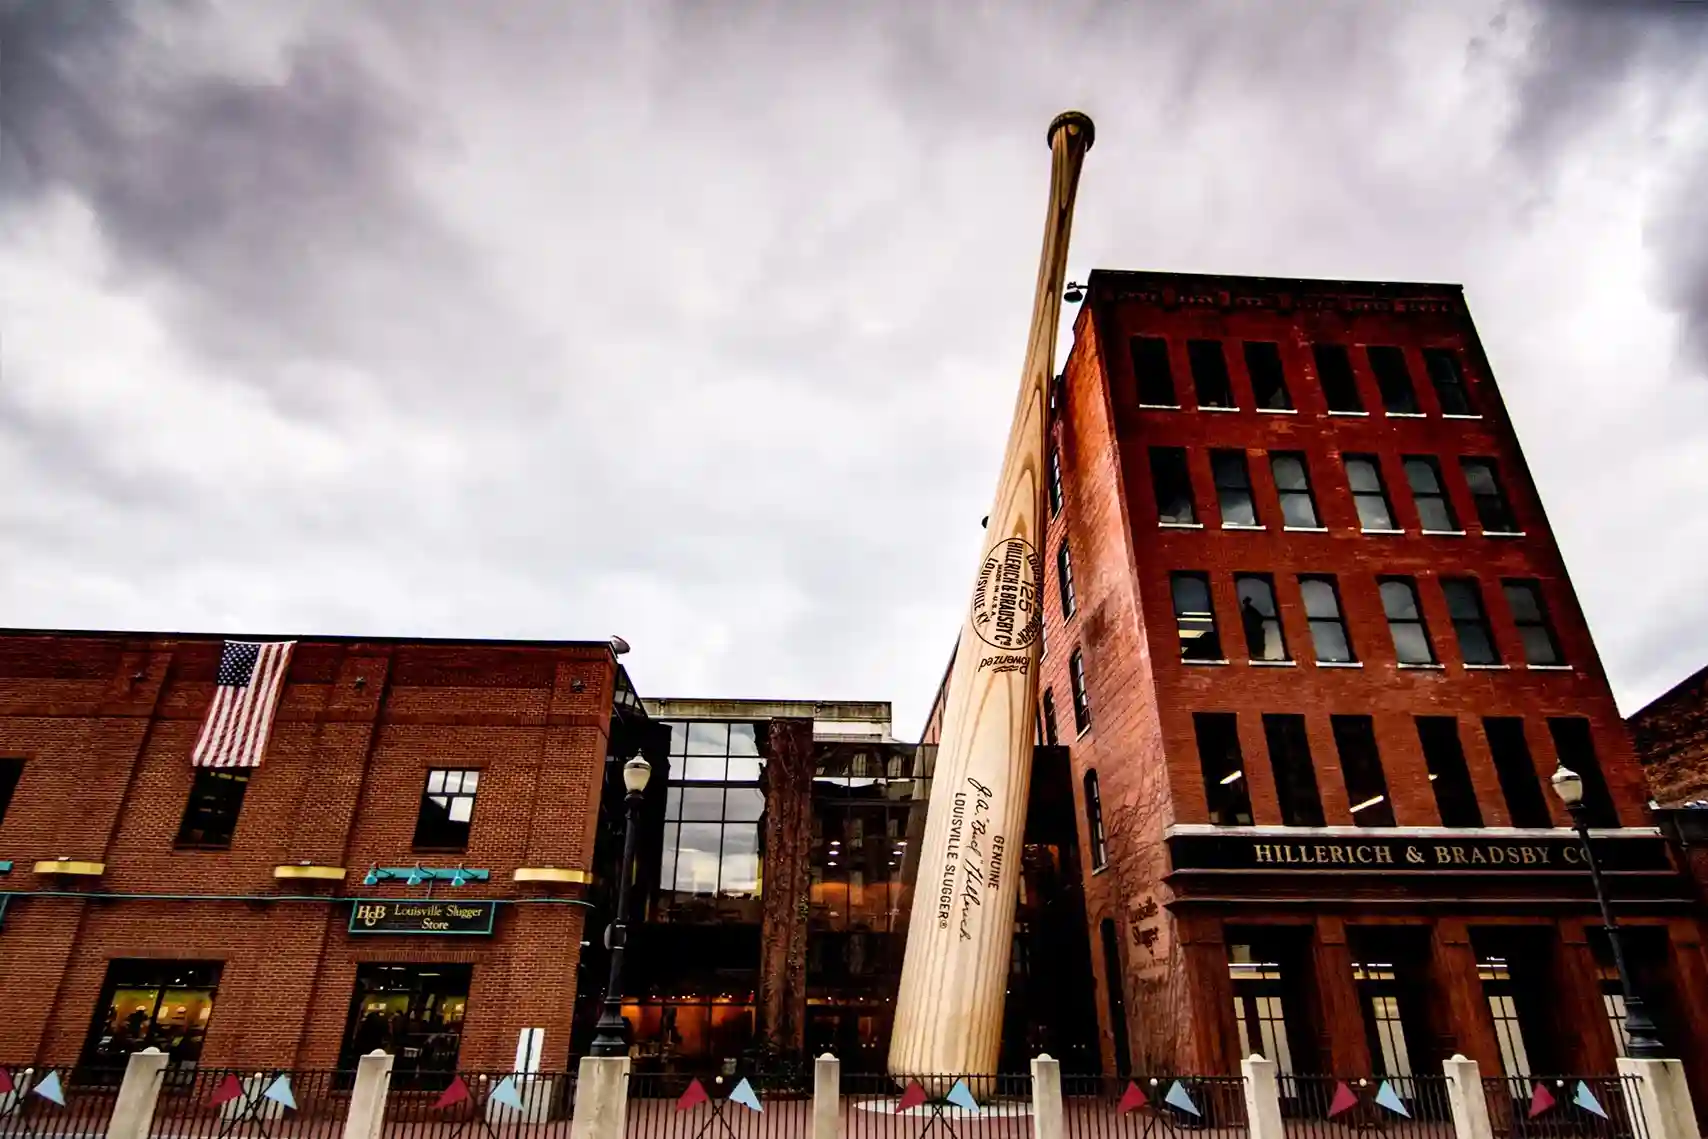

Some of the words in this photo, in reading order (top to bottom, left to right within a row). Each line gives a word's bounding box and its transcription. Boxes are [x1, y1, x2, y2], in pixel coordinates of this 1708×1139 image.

[1002, 541, 1024, 585] HILLERICH
[974, 557, 999, 611] LOUISVILLE
[1001, 584, 1018, 592] &
[1018, 580, 1035, 614] 125
[995, 592, 1017, 636] BRADSBY
[946, 792, 967, 860] LOUISVILLE
[987, 835, 1005, 892] GENUINE
[1253, 844, 1395, 864] HILLERICH
[1405, 845, 1426, 864] &
[1433, 845, 1551, 864] BRADSBY
[394, 903, 443, 916] Louisville
[446, 903, 483, 919] Slugger
[421, 917, 450, 930] Store
